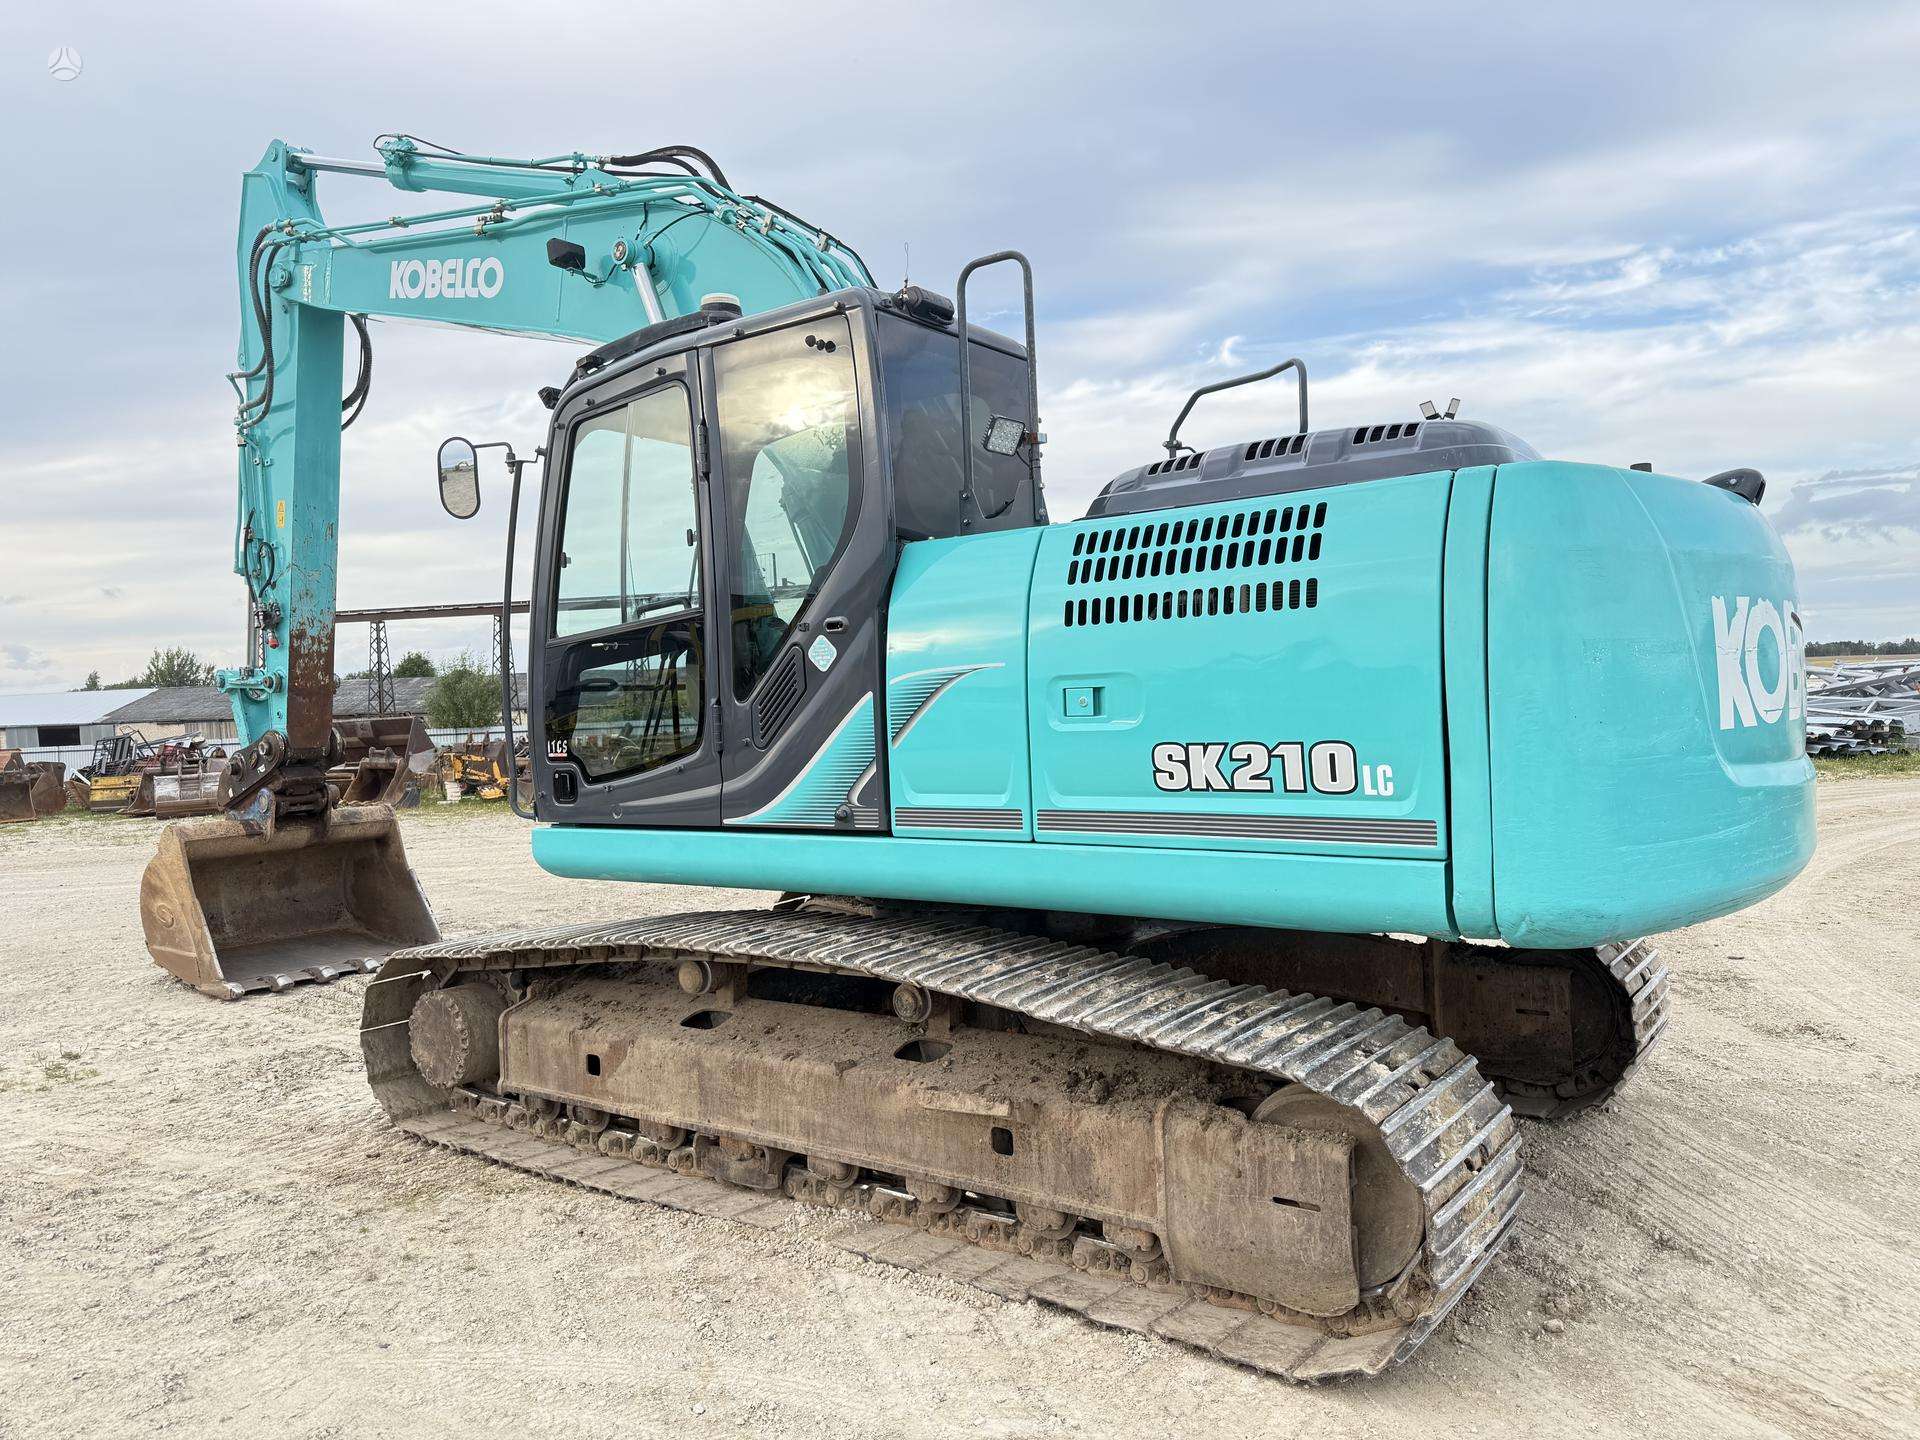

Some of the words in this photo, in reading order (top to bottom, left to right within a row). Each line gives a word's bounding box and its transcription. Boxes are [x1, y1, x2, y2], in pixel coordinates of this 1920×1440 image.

[389, 256, 505, 300] KOBELCO
[1711, 595, 1805, 730] KOB
[1152, 740, 1359, 795] SK210
[1362, 764, 1394, 797] LC
